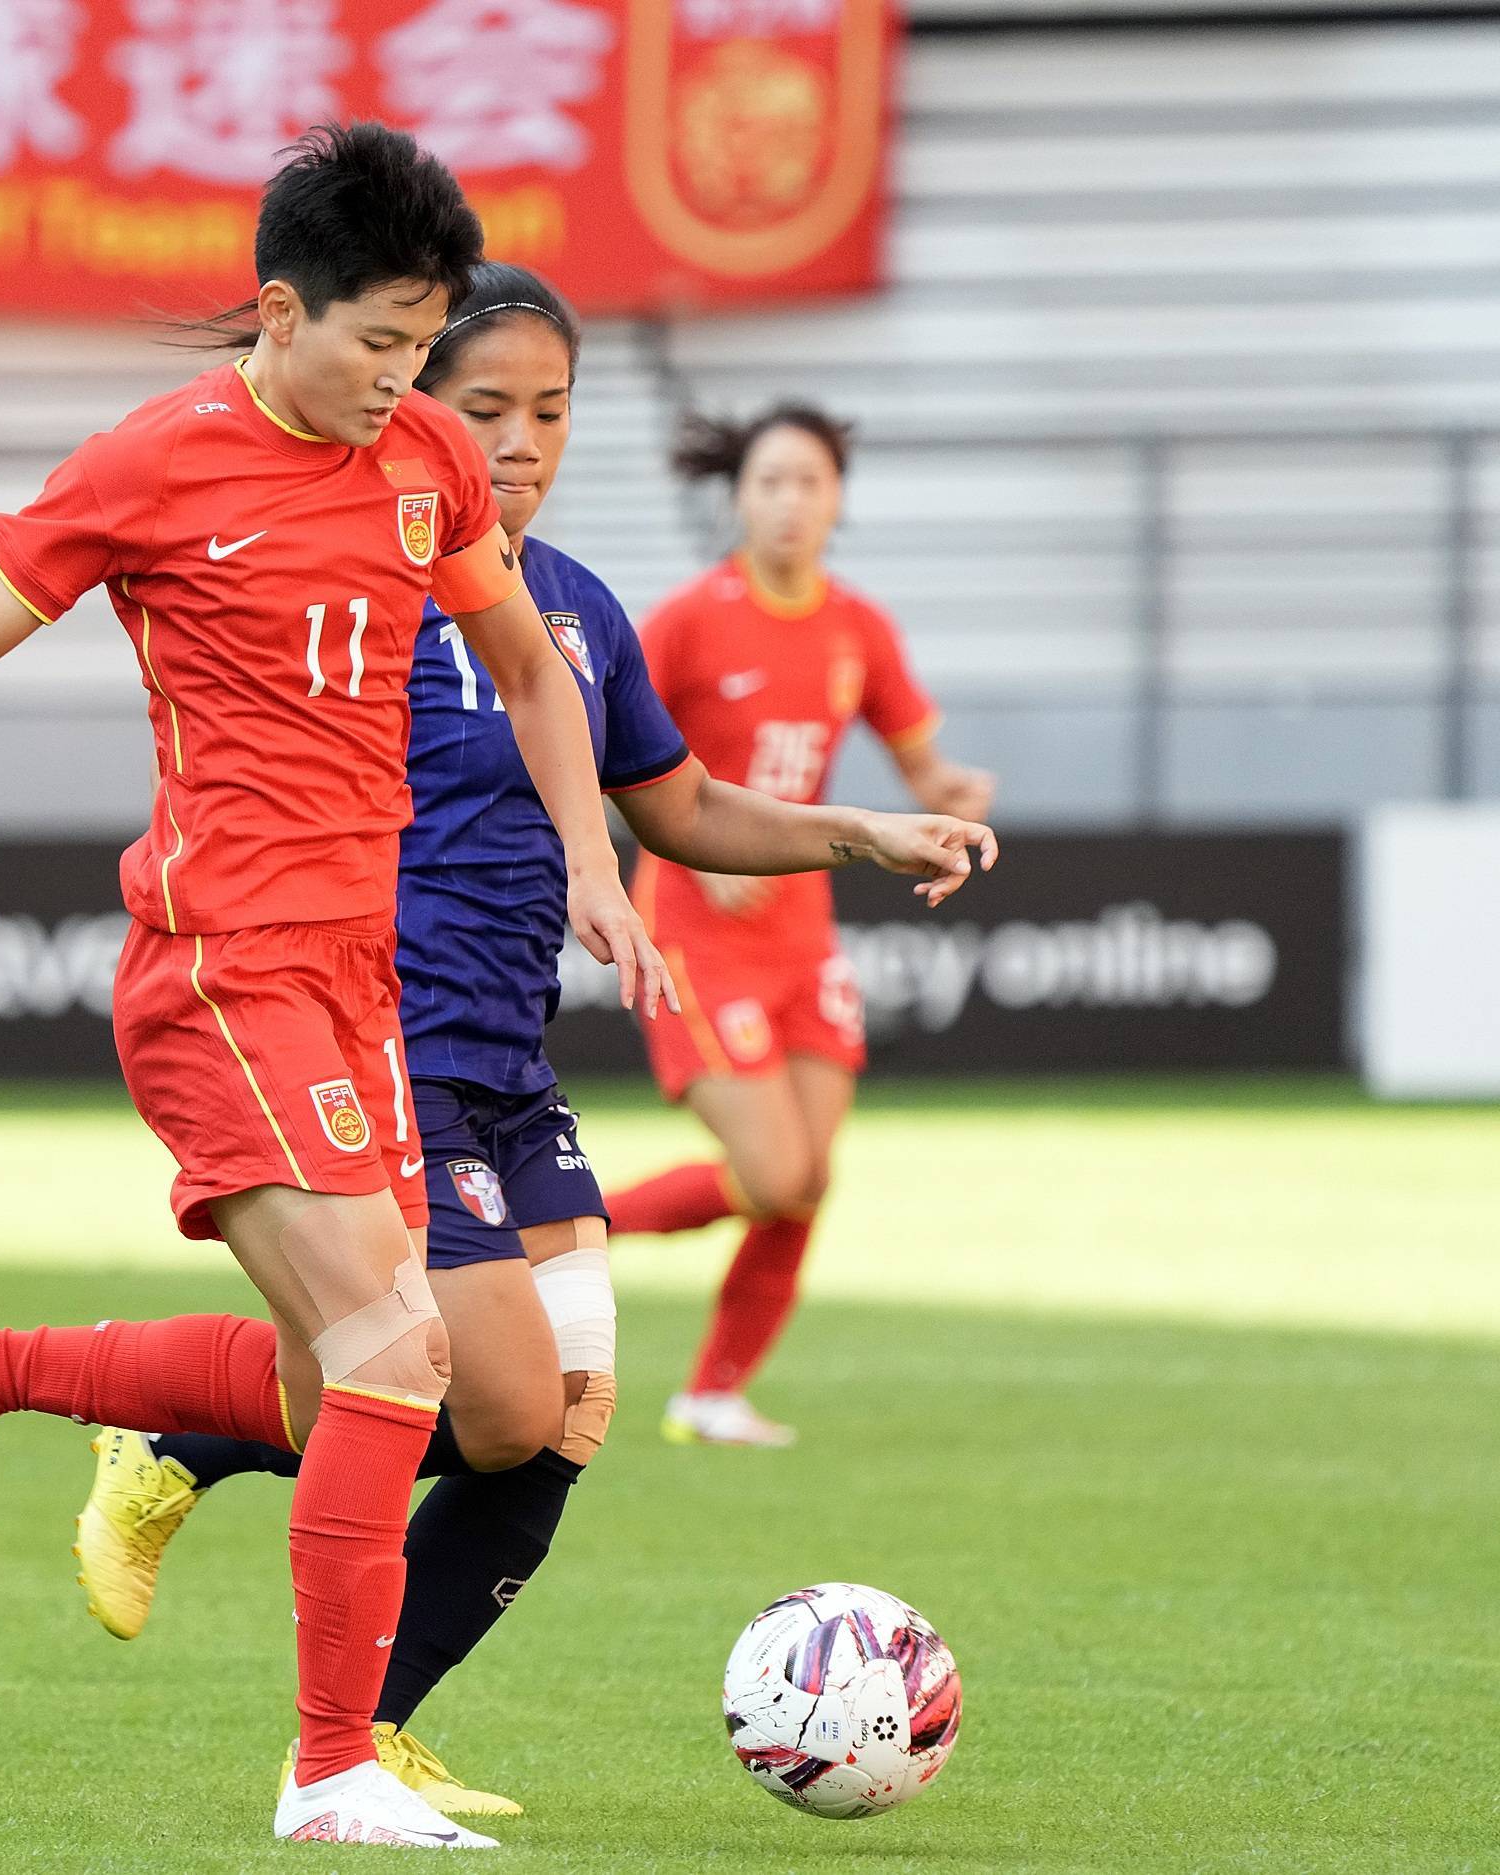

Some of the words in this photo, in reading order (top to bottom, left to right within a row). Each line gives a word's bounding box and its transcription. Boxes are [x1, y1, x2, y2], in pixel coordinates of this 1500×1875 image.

[194, 402, 232, 415] CFA
[403, 499, 432, 513] CFA
[306, 597, 368, 698] 11
[439, 620, 506, 712] 1
[982, 904, 1277, 1006] online
[319, 1087, 351, 1104] CFA
